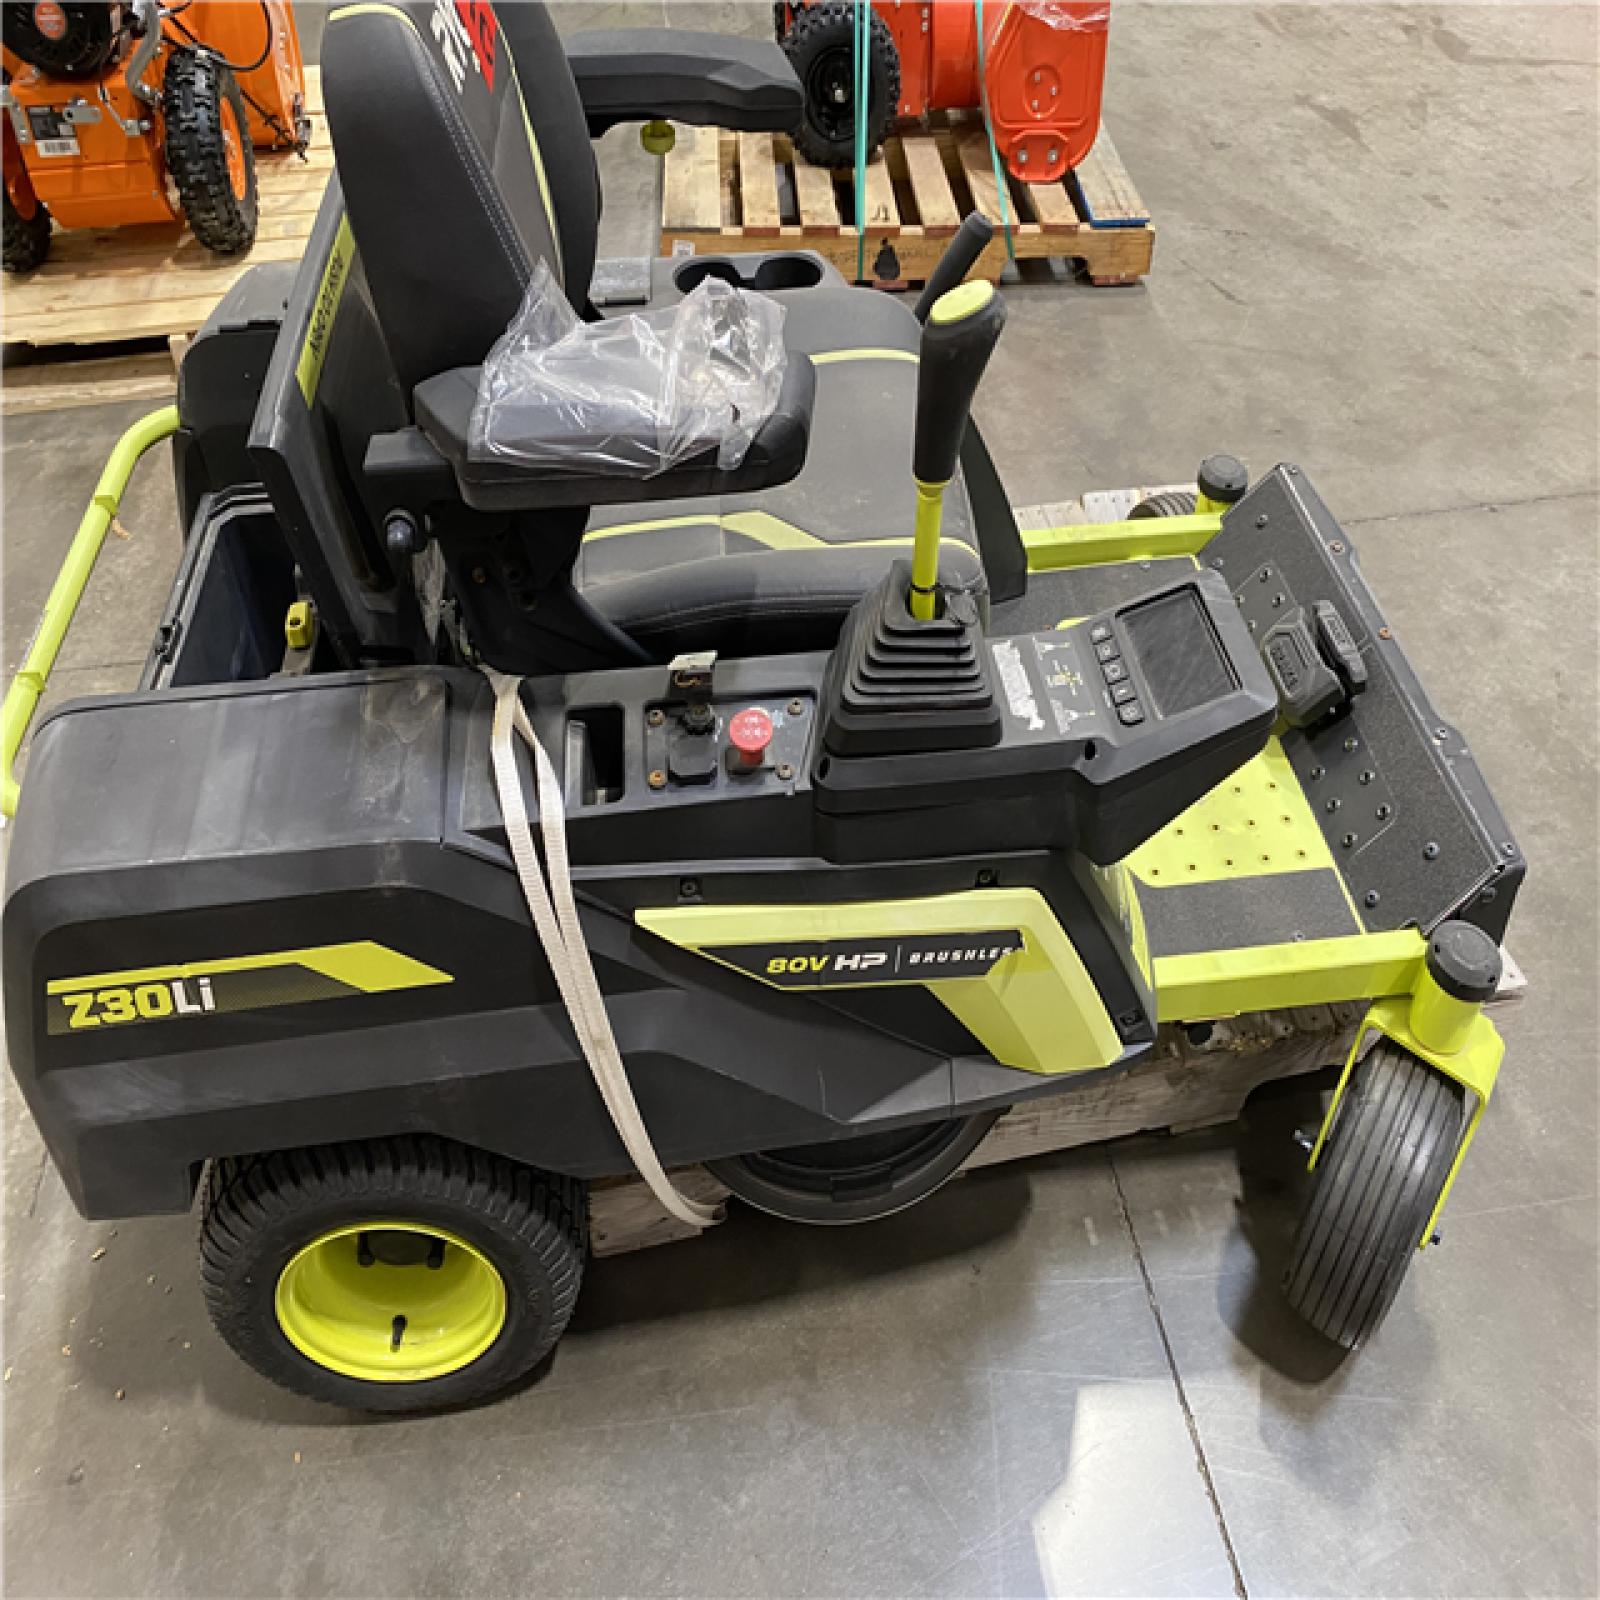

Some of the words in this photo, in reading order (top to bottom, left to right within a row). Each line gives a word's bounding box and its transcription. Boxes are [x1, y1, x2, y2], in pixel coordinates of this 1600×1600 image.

[767, 954, 830, 974] 80V
[833, 954, 888, 971] HP
[62, 977, 216, 1028] Z30Li
